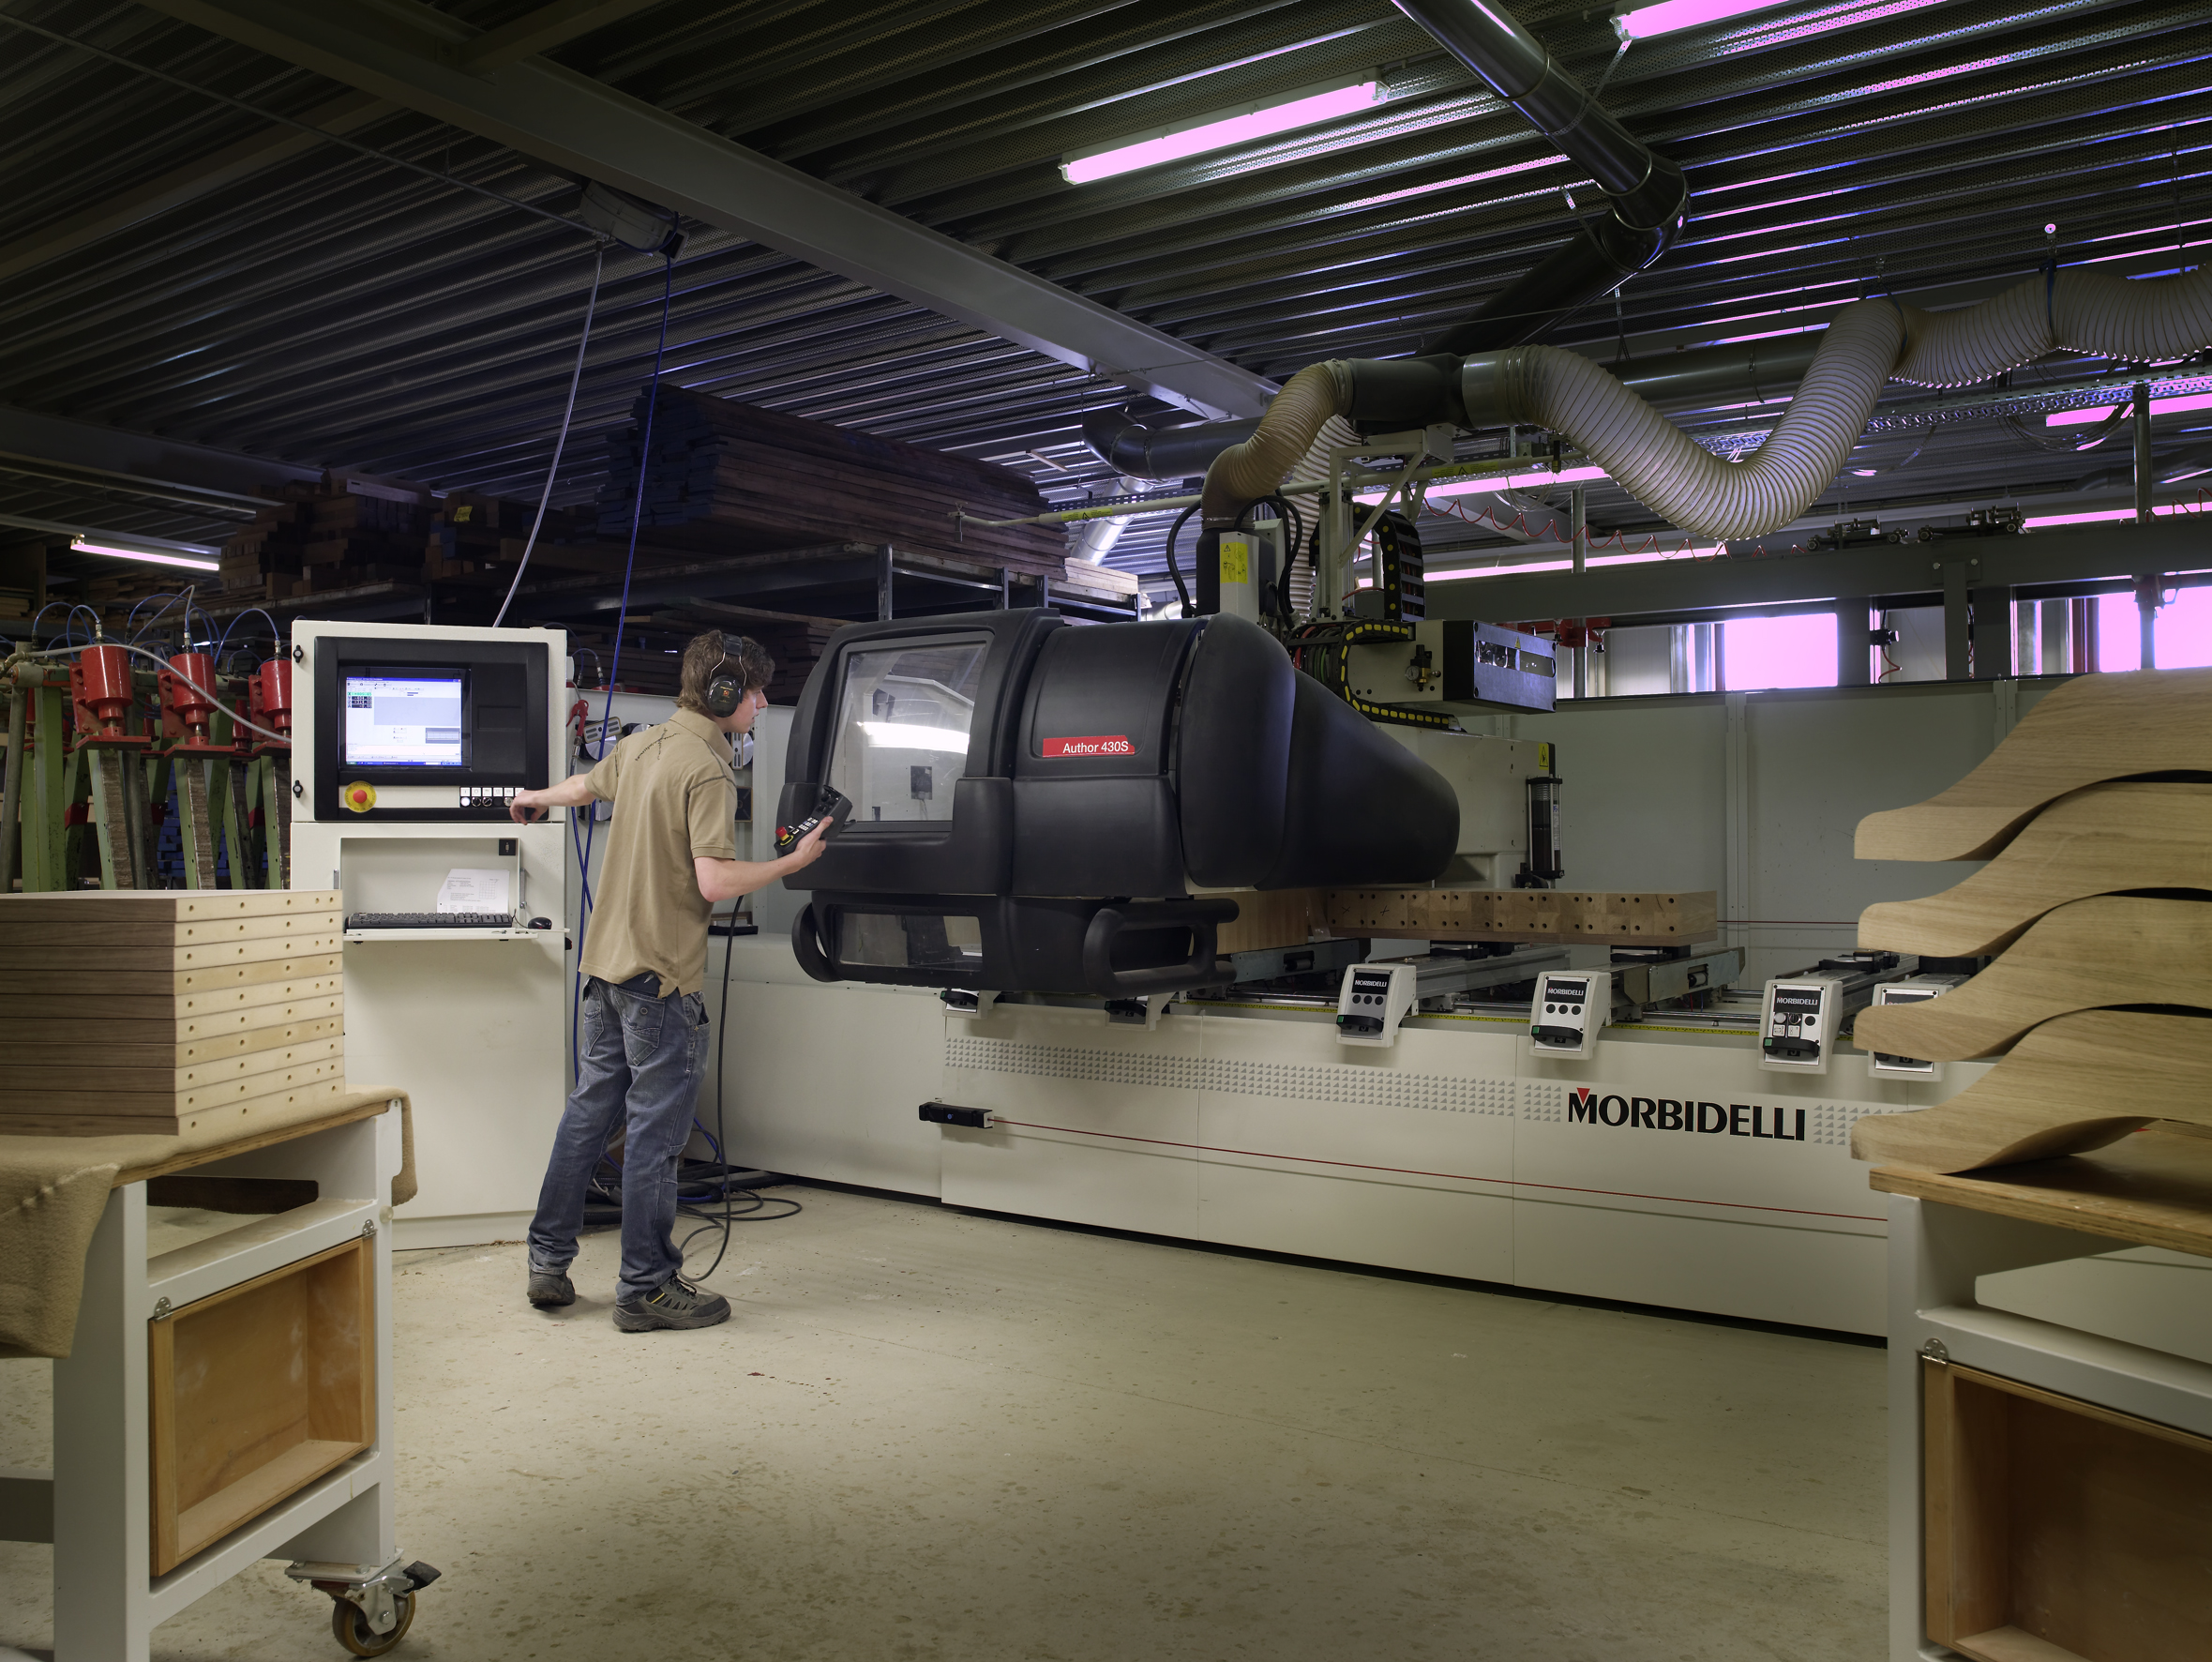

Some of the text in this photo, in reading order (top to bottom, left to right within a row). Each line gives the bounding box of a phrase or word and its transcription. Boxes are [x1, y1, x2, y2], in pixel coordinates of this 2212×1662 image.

[1062, 741, 1129, 753] Author 430S
[1547, 988, 1584, 996] MORBIDELLI
[1776, 997, 1818, 1005] MORBIDELLI
[1568, 1088, 1806, 1141] MORBIDELLI
